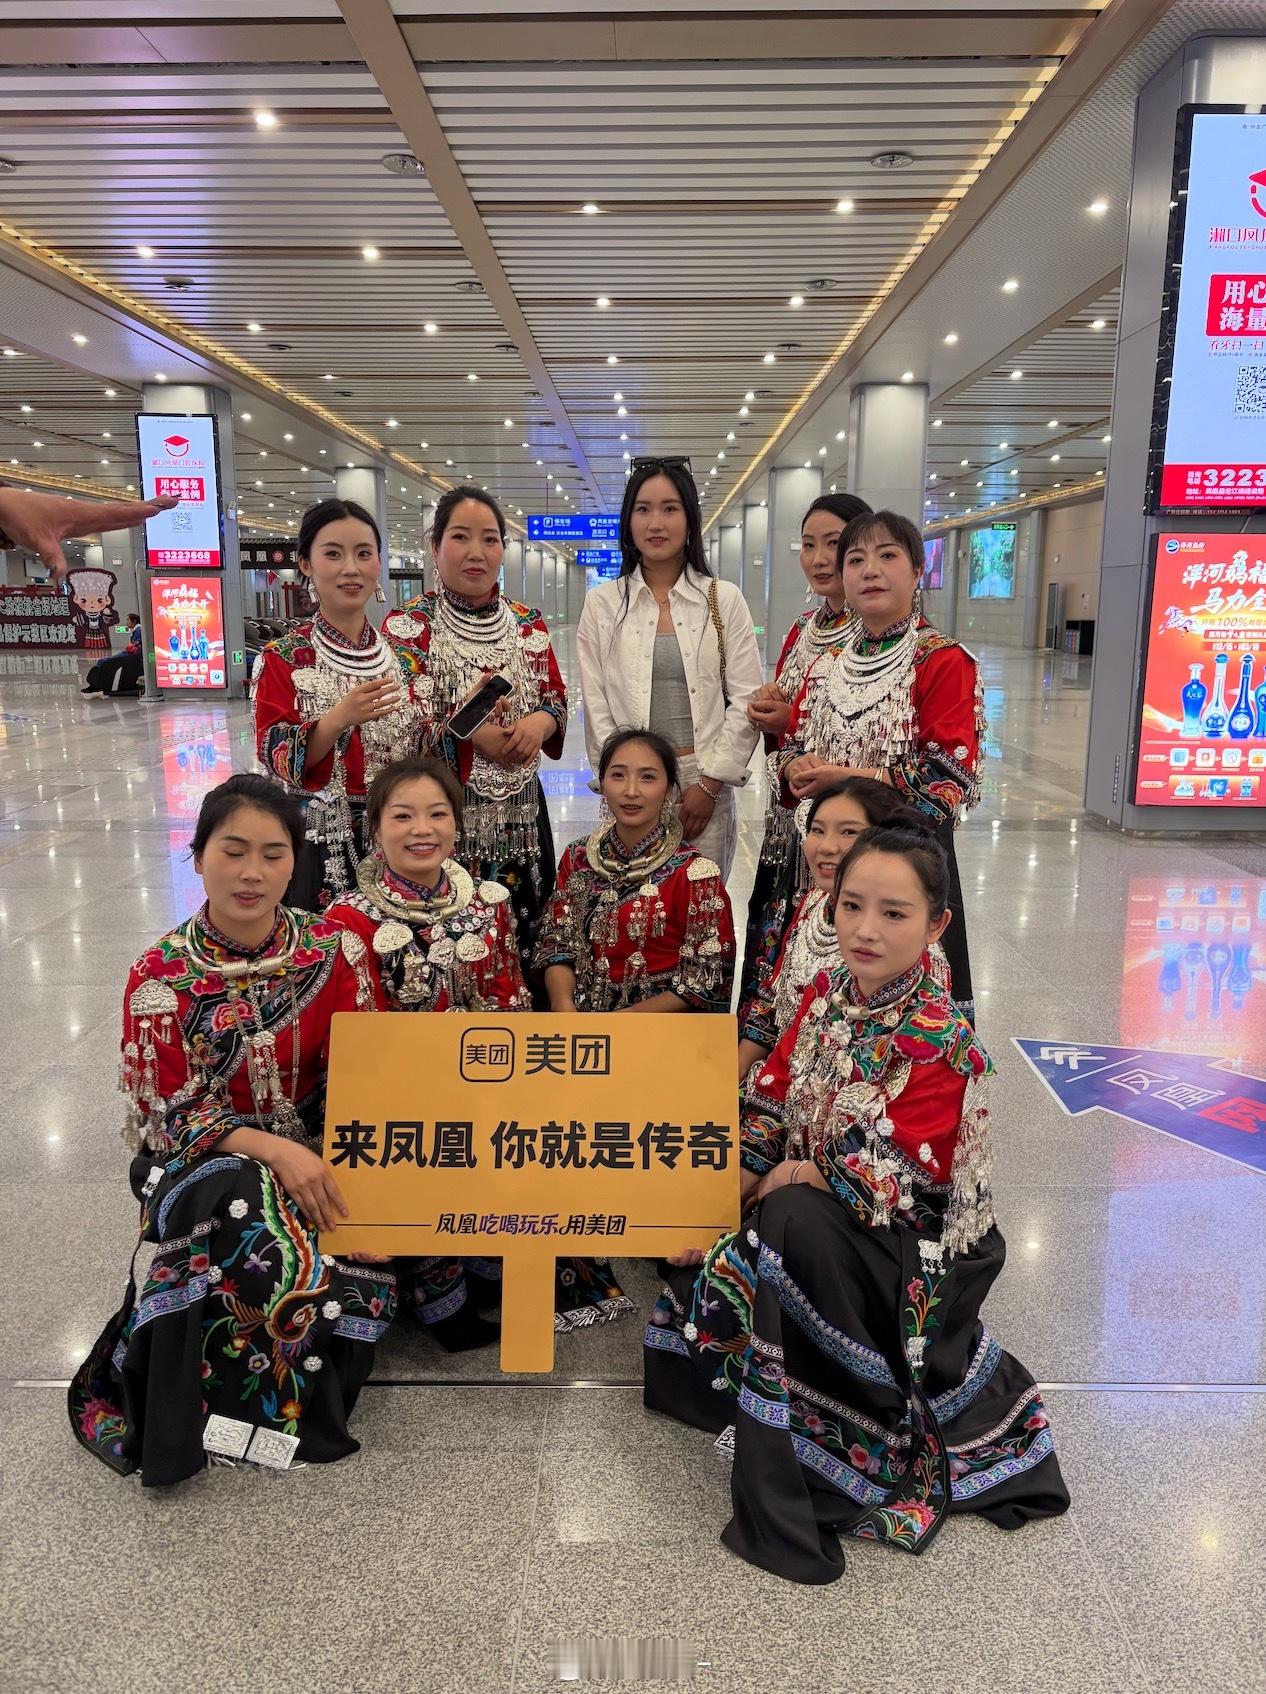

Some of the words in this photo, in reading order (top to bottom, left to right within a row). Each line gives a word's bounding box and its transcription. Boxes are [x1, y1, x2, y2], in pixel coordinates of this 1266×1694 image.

[1209, 227, 1266, 243] 湘口凤
[160, 479, 199, 489] 用心服务
[1203, 468, 1266, 487] 3223
[465, 1044, 509, 1066] 美团
[524, 1033, 611, 1076] 美团
[331, 1120, 477, 1169] 来凤凰
[490, 1120, 733, 1171] 你就是传奇
